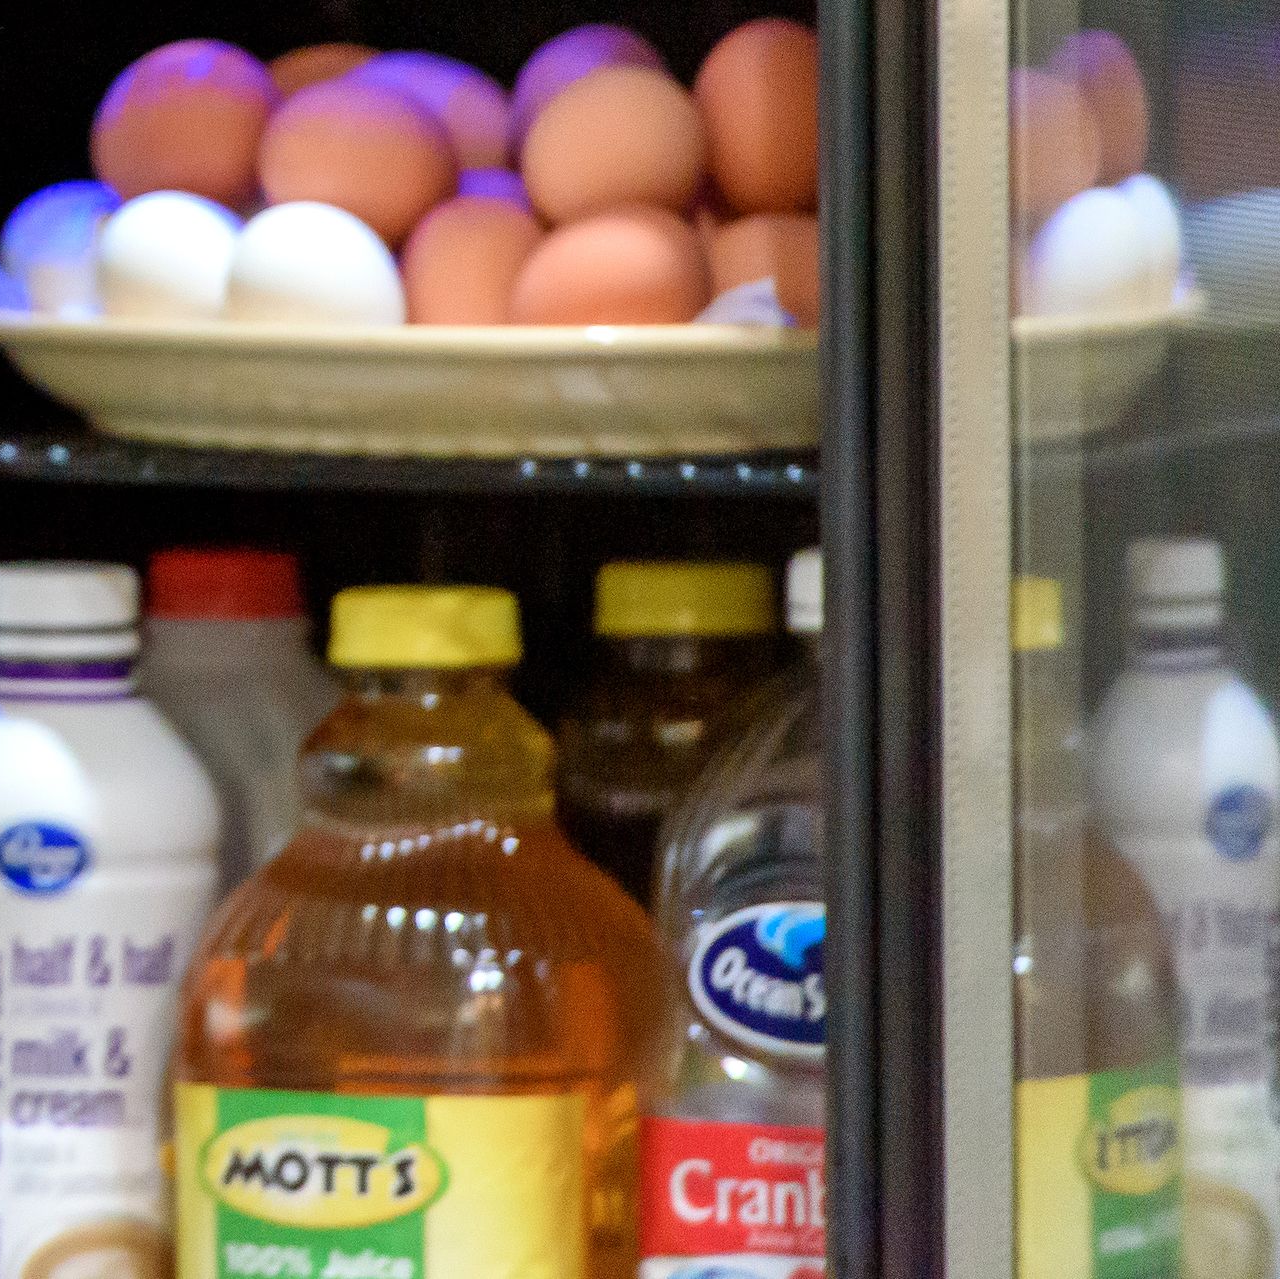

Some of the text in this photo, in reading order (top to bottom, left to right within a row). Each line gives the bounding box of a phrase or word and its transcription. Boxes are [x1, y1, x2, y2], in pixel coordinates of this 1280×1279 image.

[88, 933, 112, 987] &
[104, 1026, 131, 1080] &
[10, 1088, 125, 1128] cream
